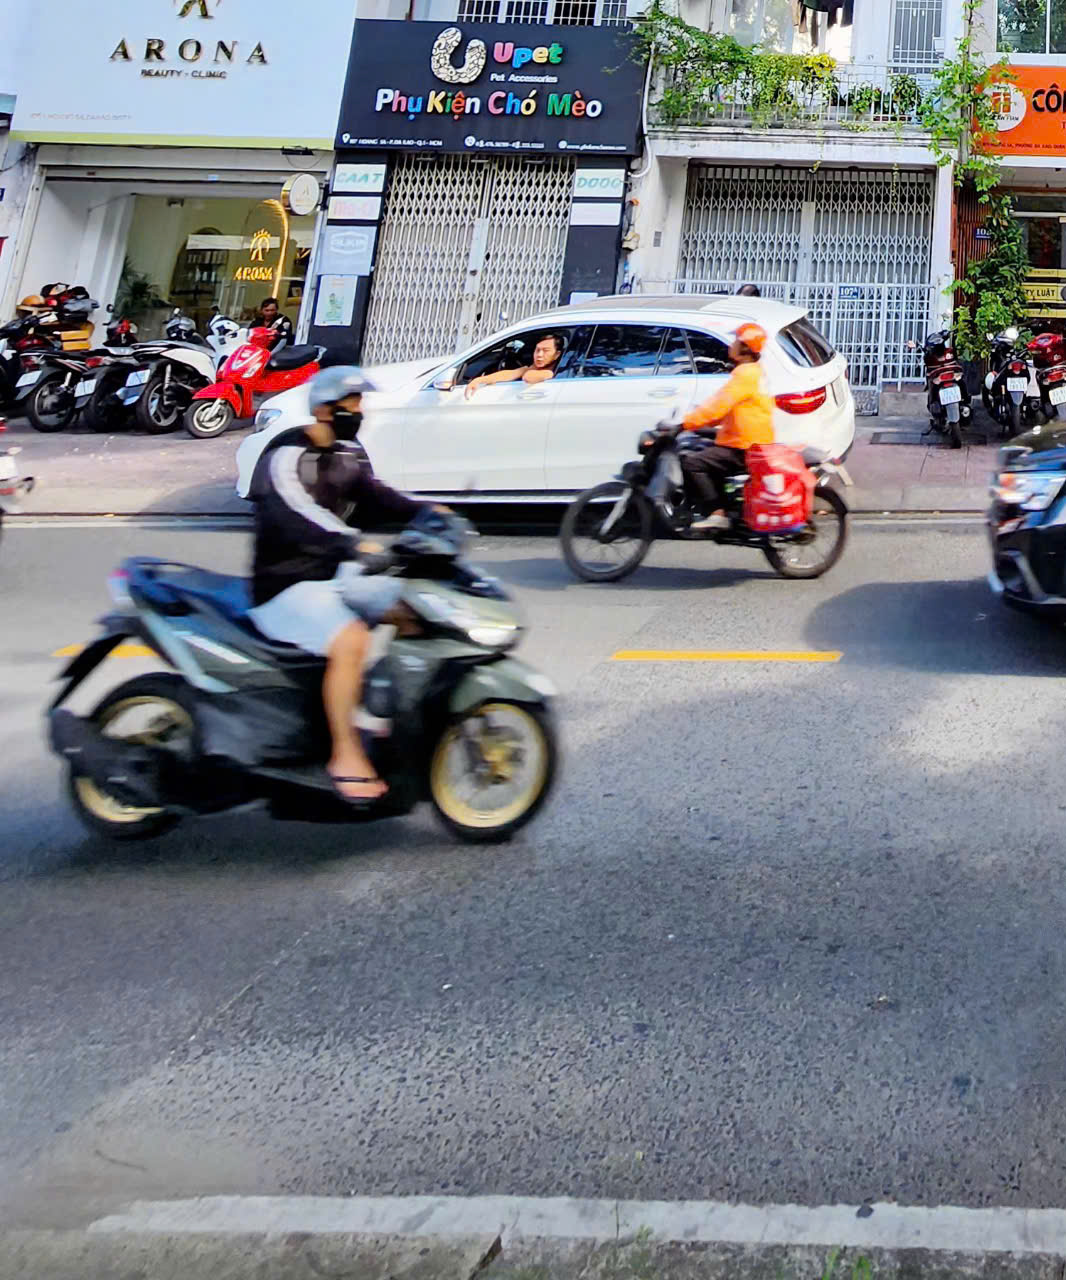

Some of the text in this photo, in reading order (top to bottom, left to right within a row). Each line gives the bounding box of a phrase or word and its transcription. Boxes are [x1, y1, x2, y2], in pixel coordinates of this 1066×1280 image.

[109, 38, 268, 65] ARONA
[493, 42, 563, 68] Upet
[141, 69, 183, 78] BEAUTY
[490, 73, 558, 84] Pet Accessories
[375, 88, 602, 120] Phụ Kiện Chó Mèo
[233, 267, 273, 280] ARONA
